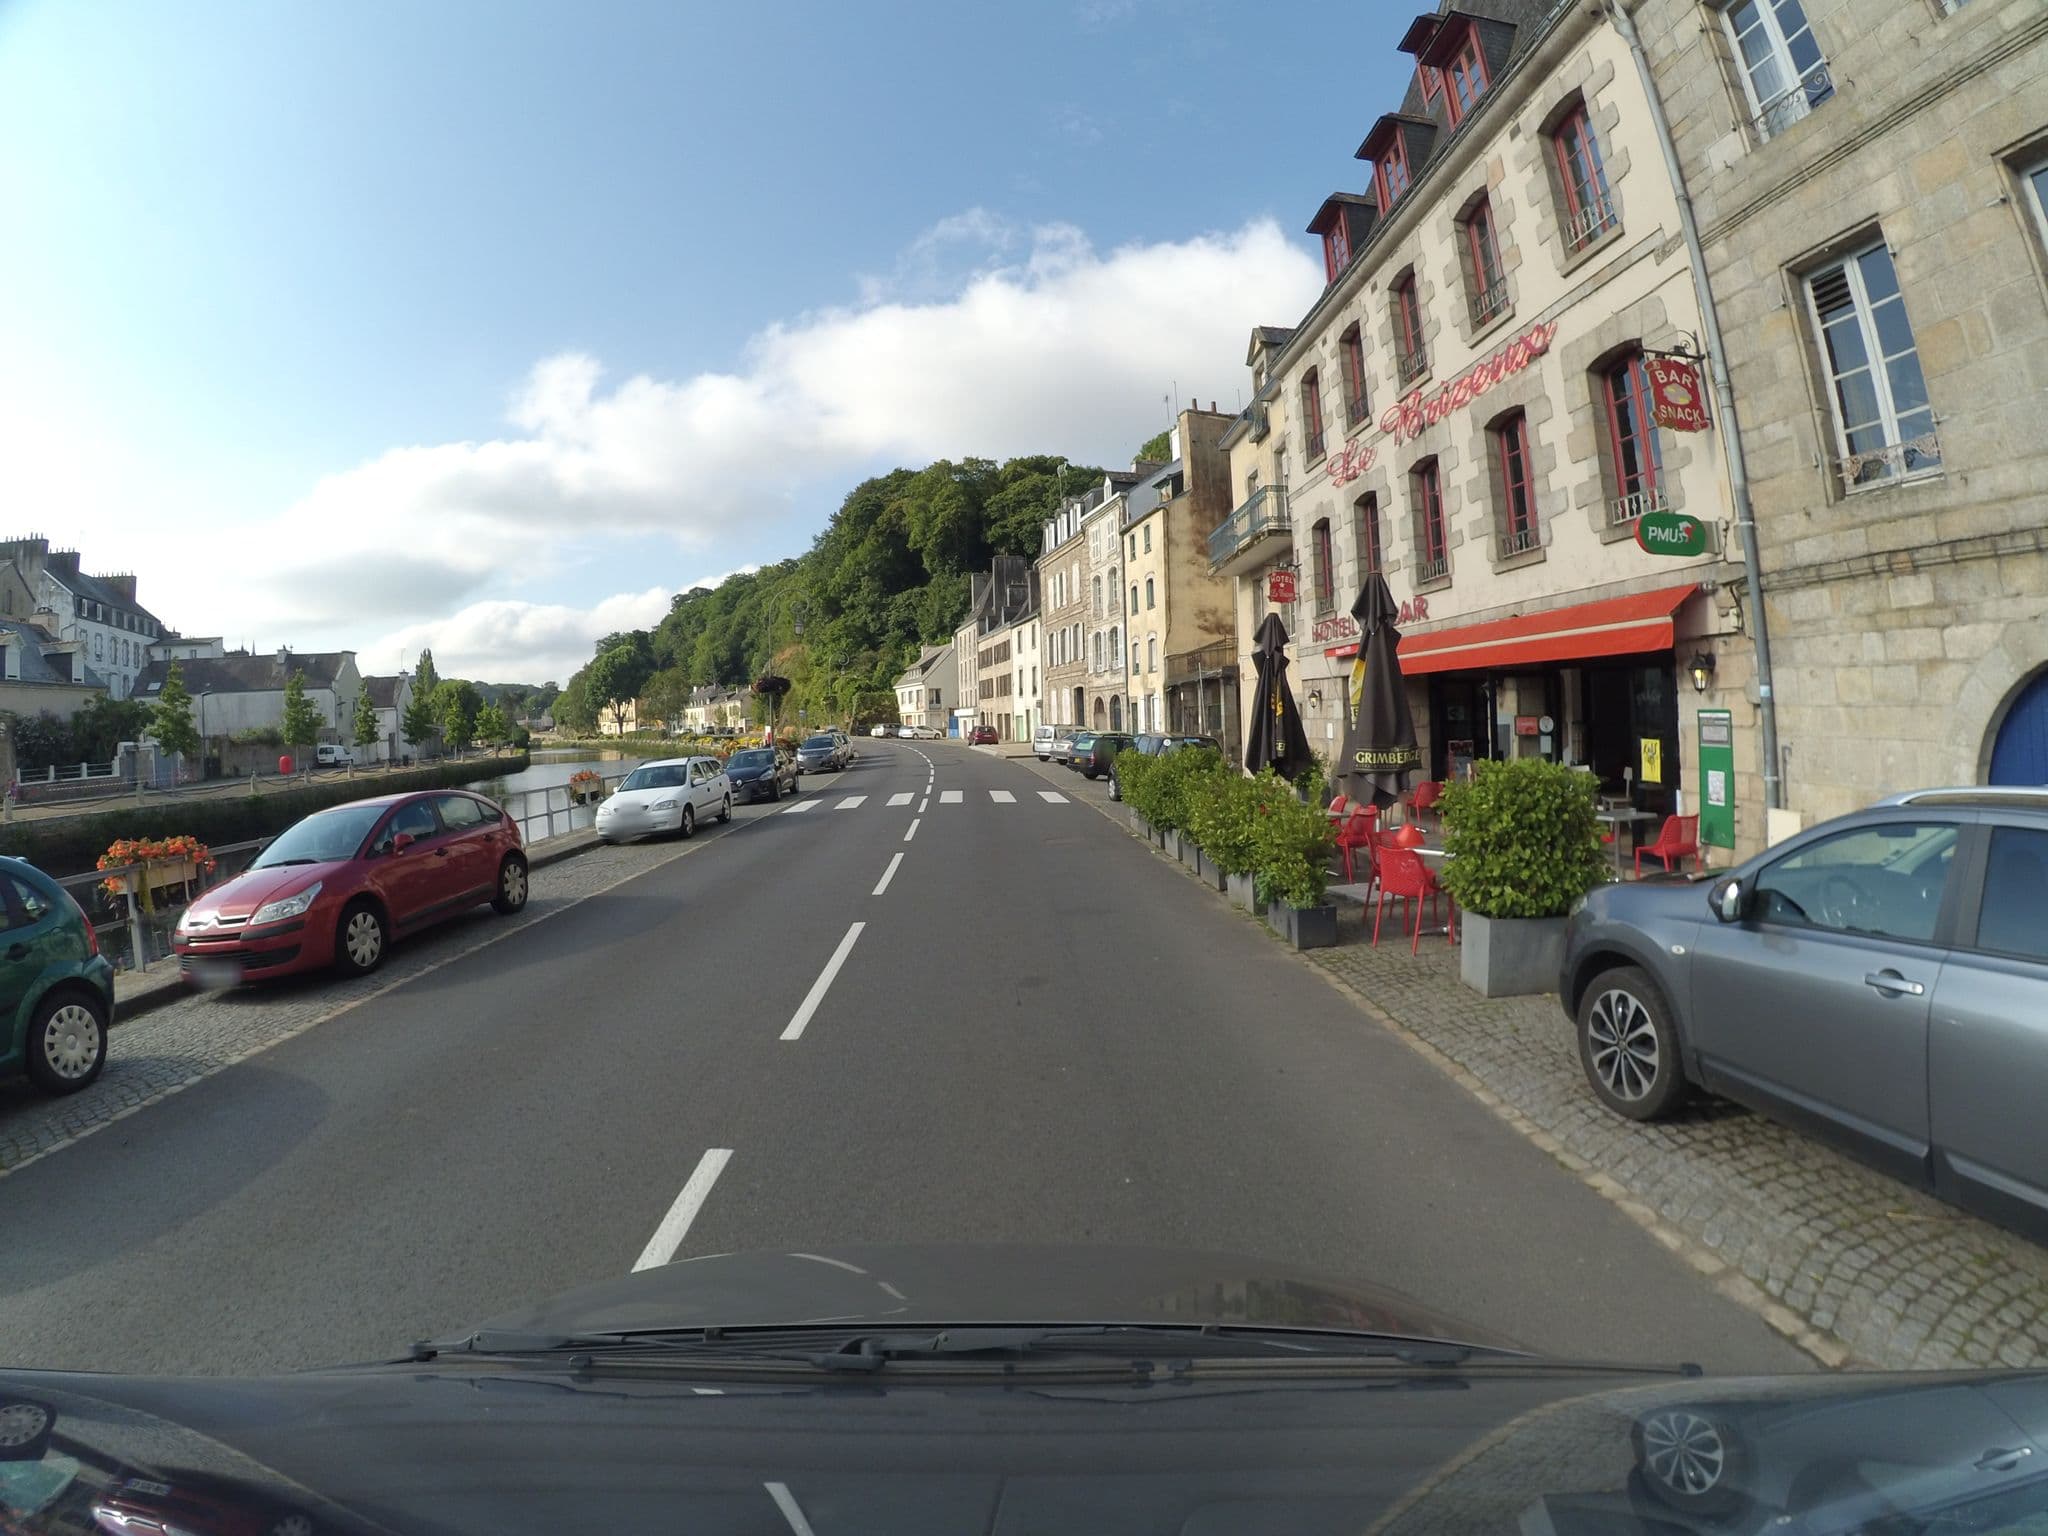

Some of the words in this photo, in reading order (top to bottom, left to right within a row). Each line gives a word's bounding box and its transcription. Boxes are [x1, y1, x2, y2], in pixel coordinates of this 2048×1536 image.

[1655, 369, 1693, 388] BAR
[1326, 437, 1378, 488] Le
[1379, 321, 1558, 446] Brizeux
[1660, 404, 1701, 421] SNACK
[1647, 526, 1678, 543] PMU
[1271, 575, 1294, 584] HOTEL
[1312, 615, 1359, 642] HOTEL
[1394, 595, 1430, 626] AR
